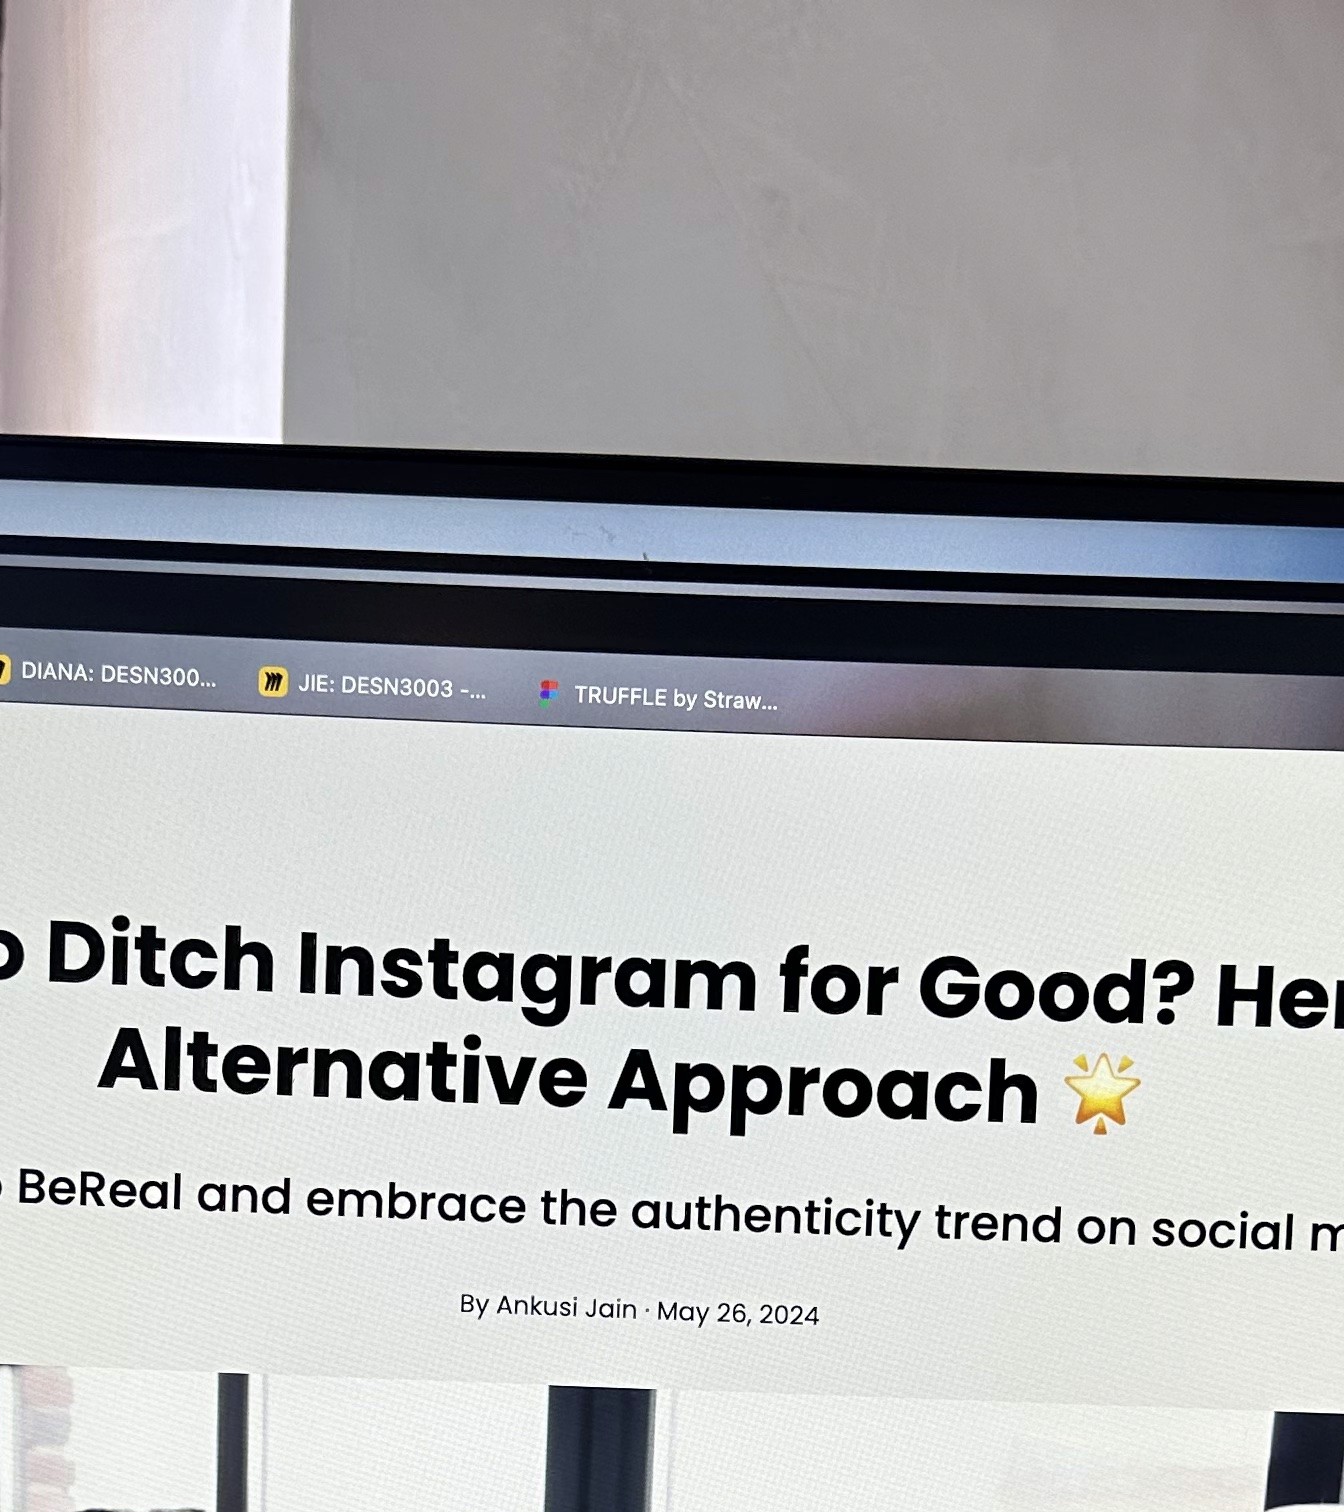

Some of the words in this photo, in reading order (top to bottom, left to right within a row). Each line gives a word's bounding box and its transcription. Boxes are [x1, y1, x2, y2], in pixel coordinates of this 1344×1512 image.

[22, 661, 94, 682] DIANA:
[101, 664, 216, 688] DESN300...
[298, 673, 335, 693] JIE:
[341, 675, 453, 698] DESN3003
[574, 685, 668, 707] TRUFFLE
[673, 688, 698, 712] by
[703, 689, 778, 711] Straw...
[48, 914, 274, 993] Ditch
[299, 931, 757, 1028] Instagram
[779, 944, 900, 1016] for
[919, 955, 1195, 1026] Good?
[96, 1024, 588, 1108] Alternative
[607, 1048, 1038, 1137] Approach
[18, 1167, 182, 1210] BeReal
[197, 1177, 291, 1215] and
[306, 1181, 526, 1224] embrace
[540, 1188, 618, 1228] the
[631, 1194, 922, 1251] authenticity
[934, 1204, 1062, 1243] trend
[1077, 1215, 1136, 1246] on
[1151, 1210, 1294, 1251] social
[460, 1293, 490, 1320] By
[496, 1295, 578, 1317] Ankusi
[585, 1298, 637, 1320] Jain
[657, 1301, 710, 1329] May
[717, 1302, 752, 1327] 26,
[759, 1304, 820, 1326] 2024
